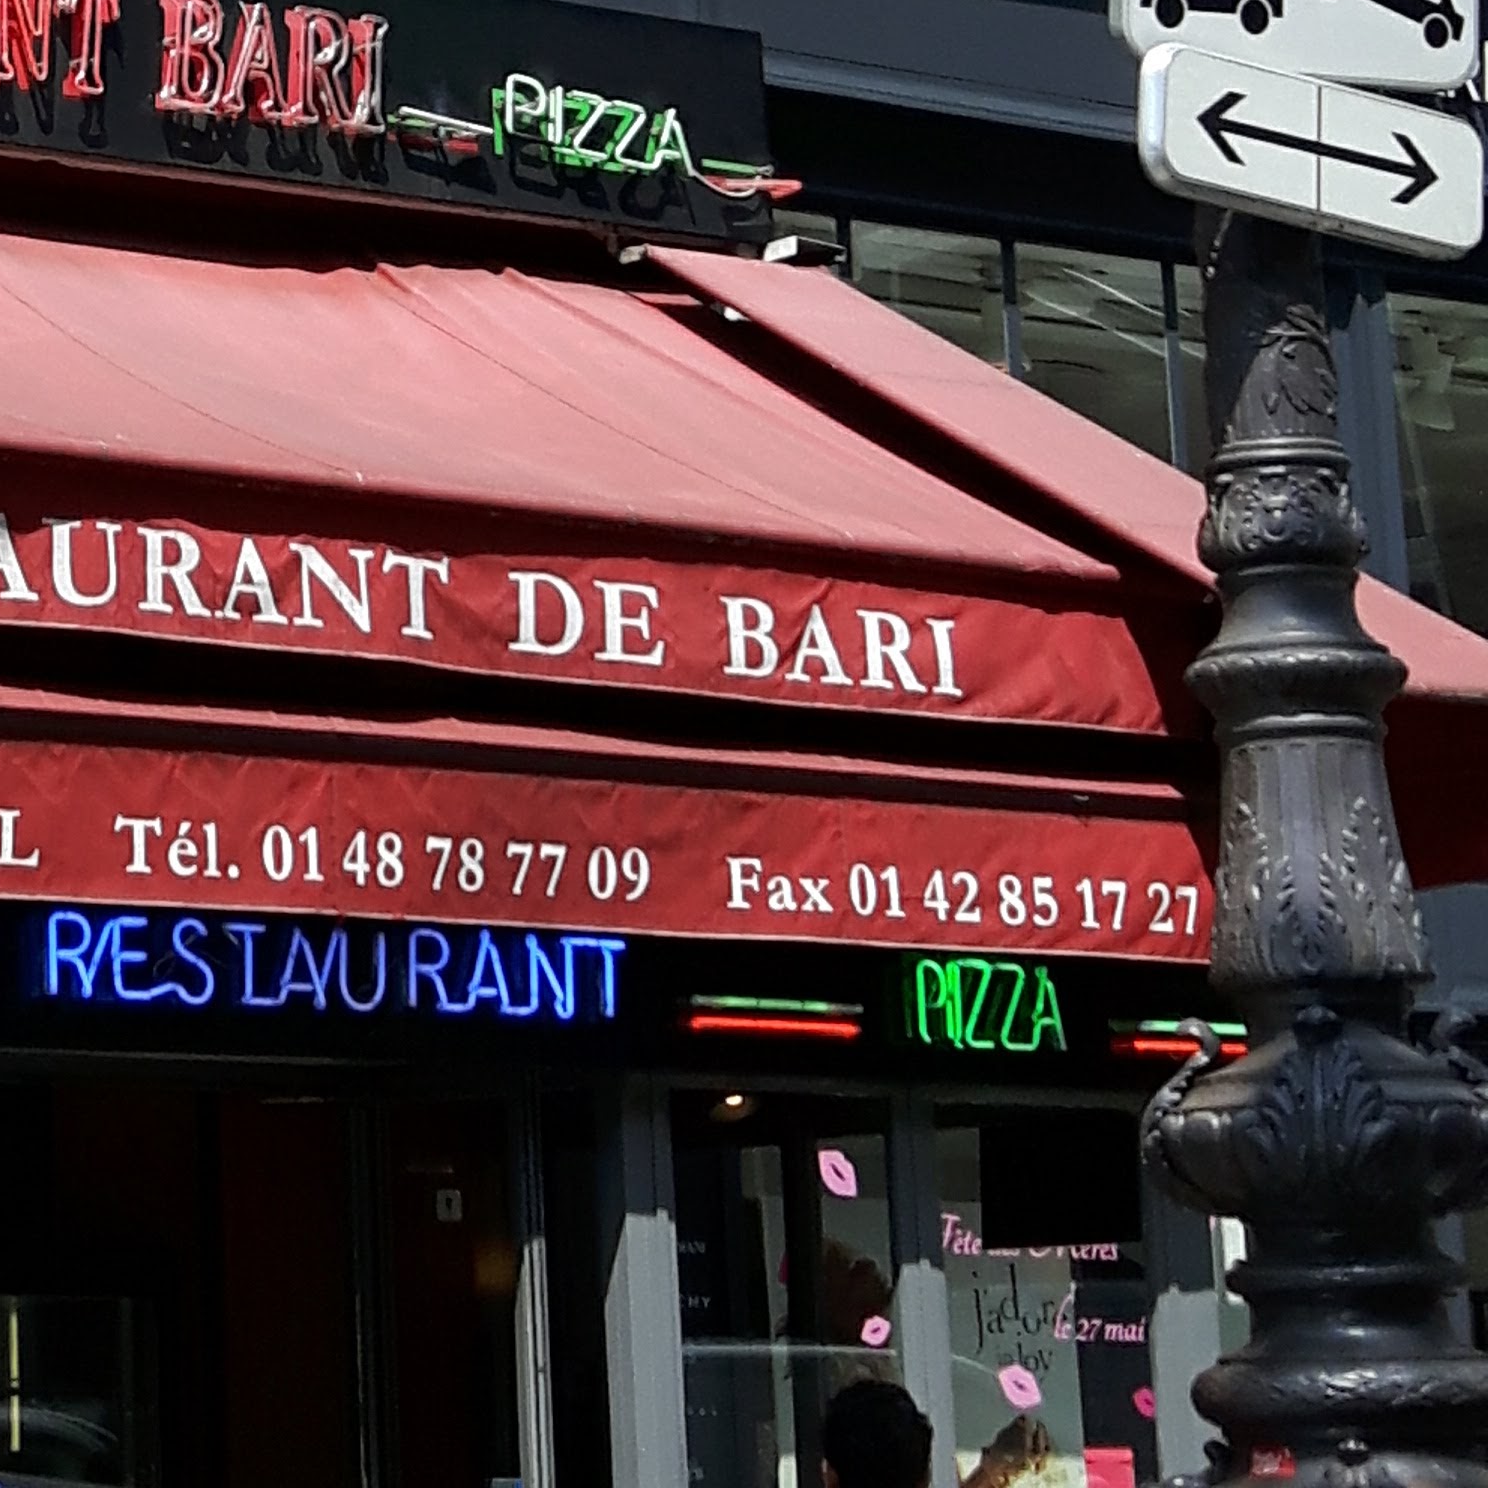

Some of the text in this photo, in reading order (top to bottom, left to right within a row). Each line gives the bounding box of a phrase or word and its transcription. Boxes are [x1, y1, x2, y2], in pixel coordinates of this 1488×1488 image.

[491, 74, 696, 176] PIZZA
[507, 571, 665, 668] DE
[718, 595, 962, 699] BARI
[113, 813, 241, 880] Tél.
[261, 824, 325, 883] 01
[341, 829, 404, 889] 48
[425, 835, 484, 894] 78
[506, 841, 568, 898] 77
[587, 845, 650, 902] 09
[725, 856, 834, 914] Fax
[849, 862, 905, 919] 01
[923, 868, 982, 925] 42
[998, 874, 1058, 929] 85
[1076, 878, 1130, 933] 17
[1147, 883, 1199, 937] 27
[47, 910, 626, 1019] RESTAURANT
[915, 958, 1068, 1051] PIZZA
[1075, 1319, 1101, 1341] 27
[1104, 1317, 1145, 1341] mai
